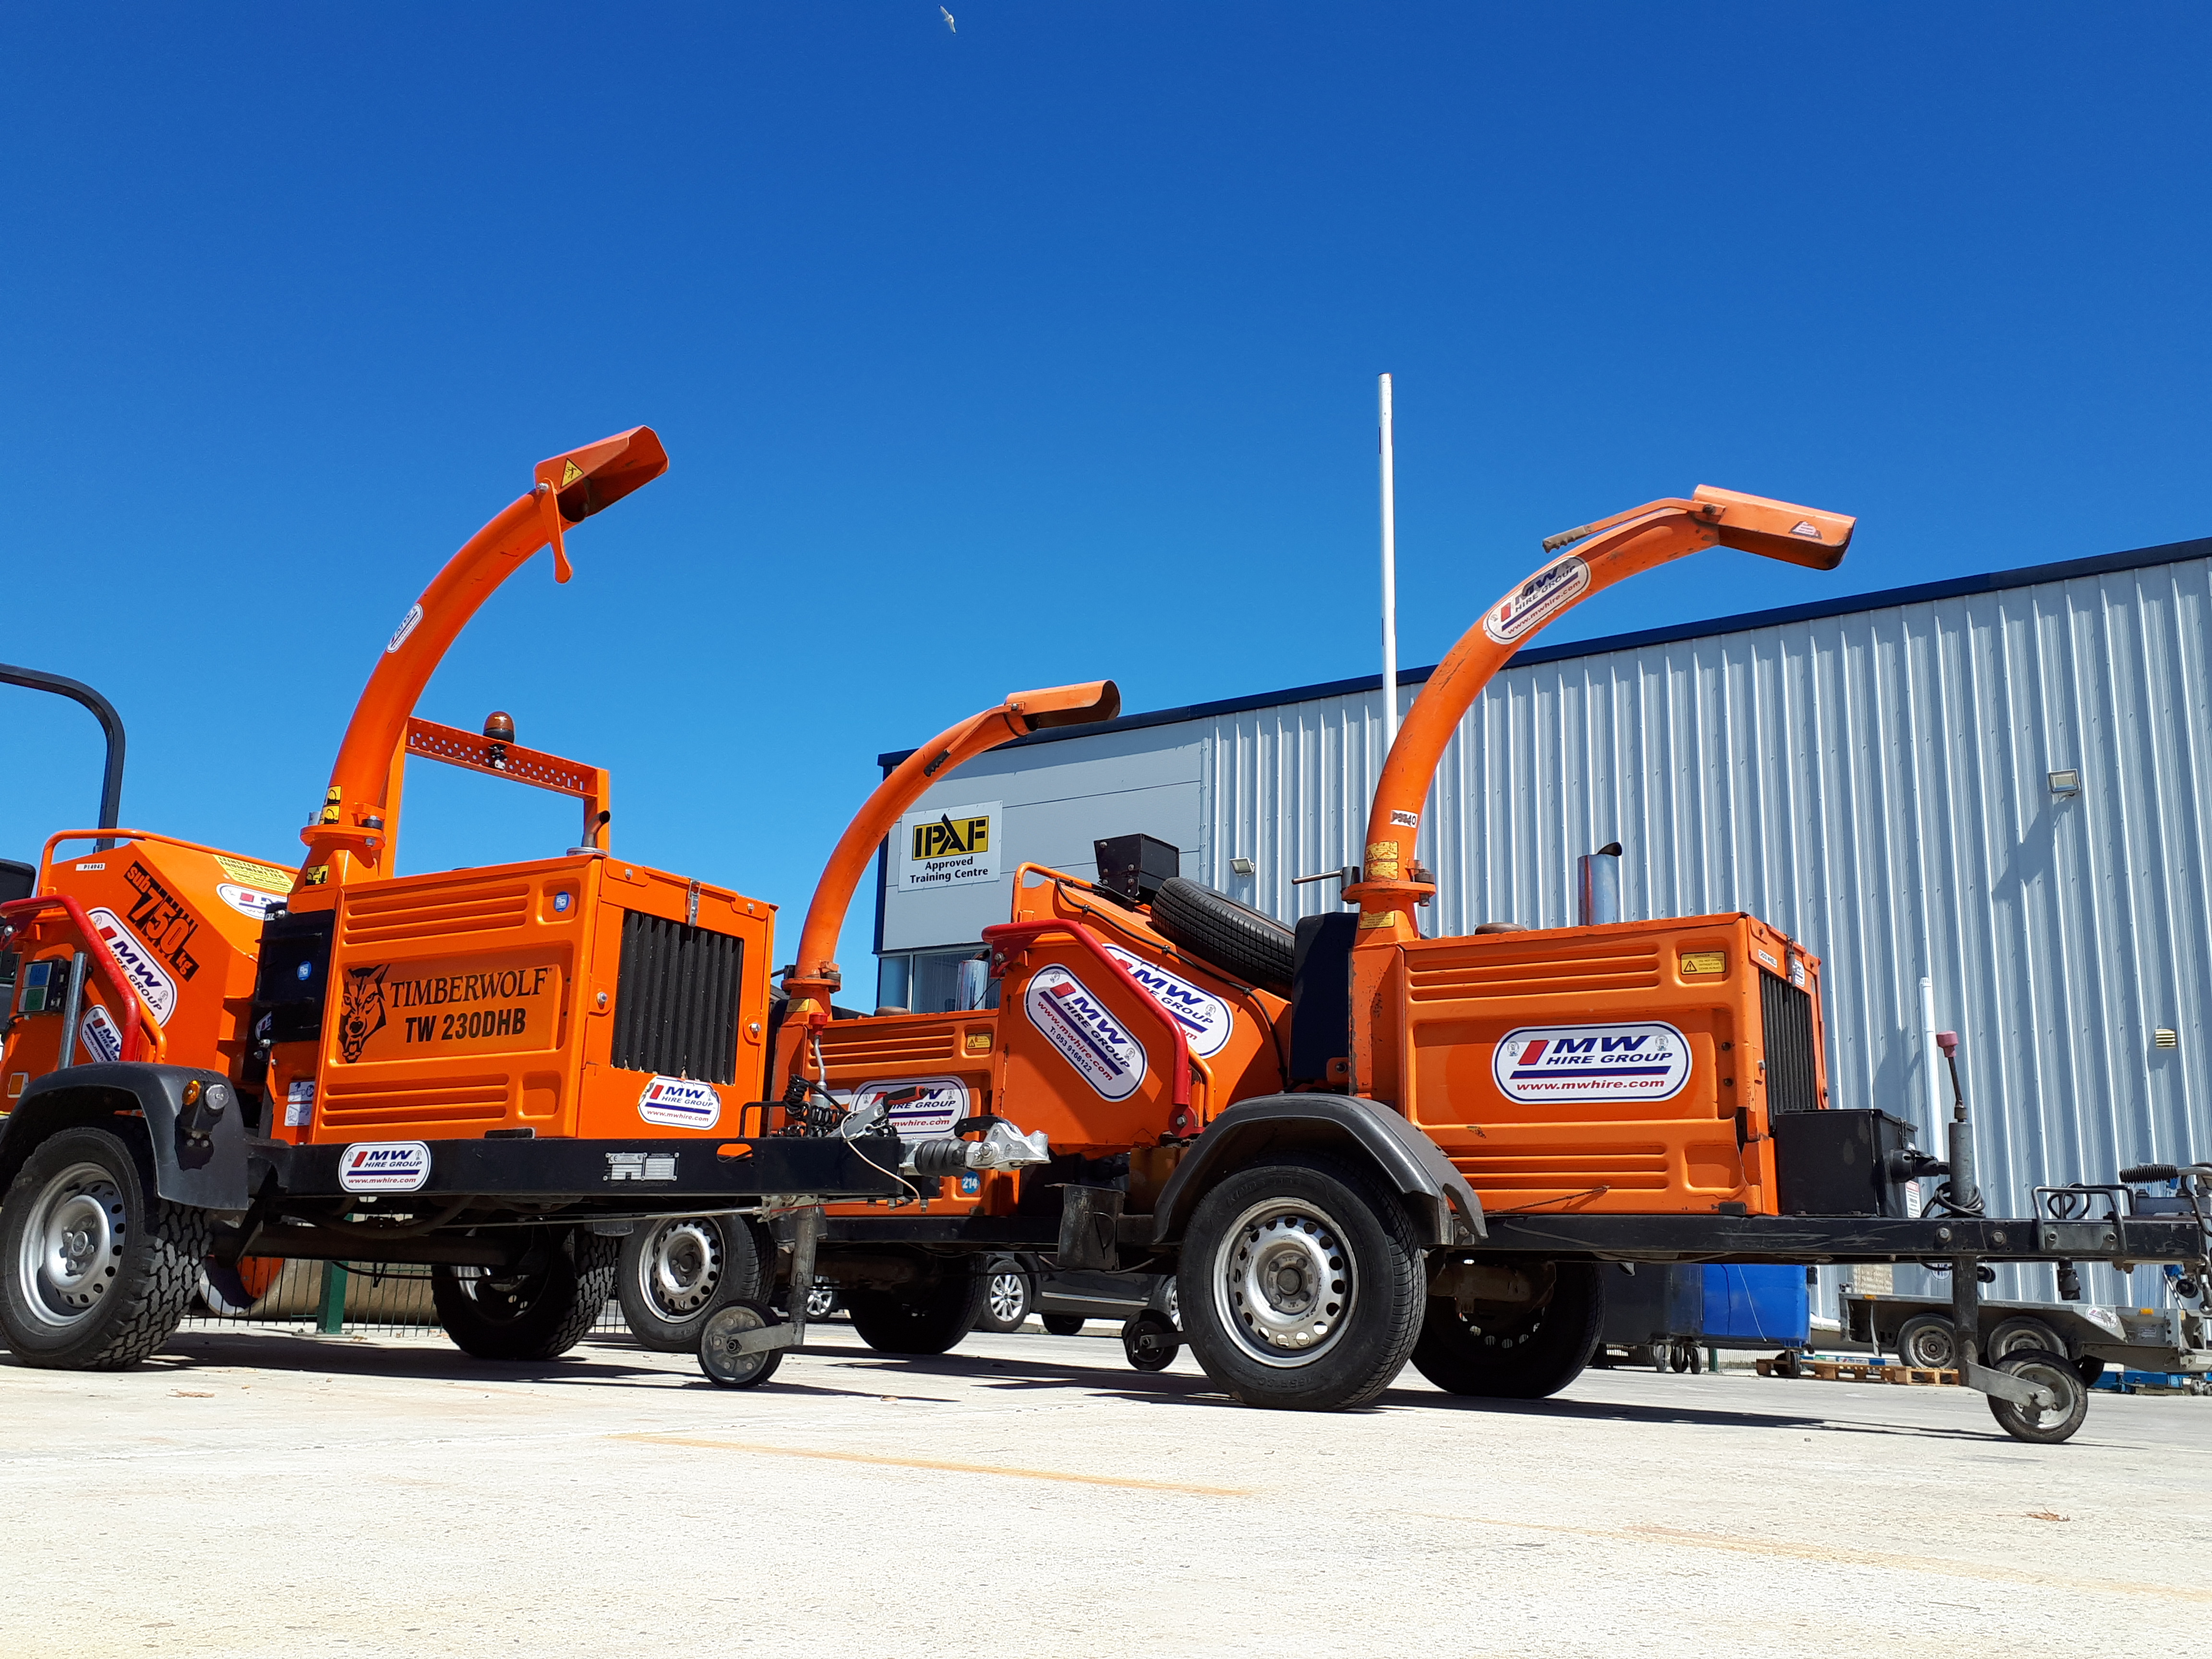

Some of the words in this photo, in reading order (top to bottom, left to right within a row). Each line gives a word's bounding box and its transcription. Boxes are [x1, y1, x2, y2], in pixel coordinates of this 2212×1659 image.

[1515, 592, 1539, 612] HIRE
[1541, 565, 1575, 593] GROUP
[1508, 580, 1580, 634] www.mwhire.com
[915, 813, 986, 857] IPAF
[910, 872, 951, 883] Training
[955, 868, 988, 878] Centre
[925, 856, 973, 872] Approved
[127, 866, 151, 893] sub
[131, 887, 189, 954] 750
[113, 940, 162, 987] MW
[176, 951, 193, 975] kg
[129, 974, 162, 1010] GROUP
[390, 968, 548, 1008] TIMBERWOLF
[1133, 969, 1205, 1005] MW
[1072, 997, 1128, 1044] MW
[1161, 997, 1214, 1023] GROUP
[405, 1015, 437, 1043] TW
[441, 1008, 526, 1040] 230DHB
[1063, 1002, 1091, 1028] HIRE
[1091, 1030, 1130, 1068] GROUP
[98, 1031, 111, 1049] HIRE
[1037, 1001, 1113, 1081] www.mwhire.com
[1056, 1034, 1067, 1046] 053
[1067, 1045, 1092, 1072] 9168122
[1552, 1035, 1650, 1054] MW
[1546, 1055, 1595, 1065] HIRE
[1600, 1053, 1673, 1063] GROUP
[665, 1086, 705, 1099] MW
[1517, 1080, 1665, 1090] www.mwhire.com
[647, 1110, 709, 1122] www.mwhire.com
[892, 1101, 914, 1109] IRE
[368, 1150, 414, 1160] MW
[962, 1177, 977, 1189] 214
